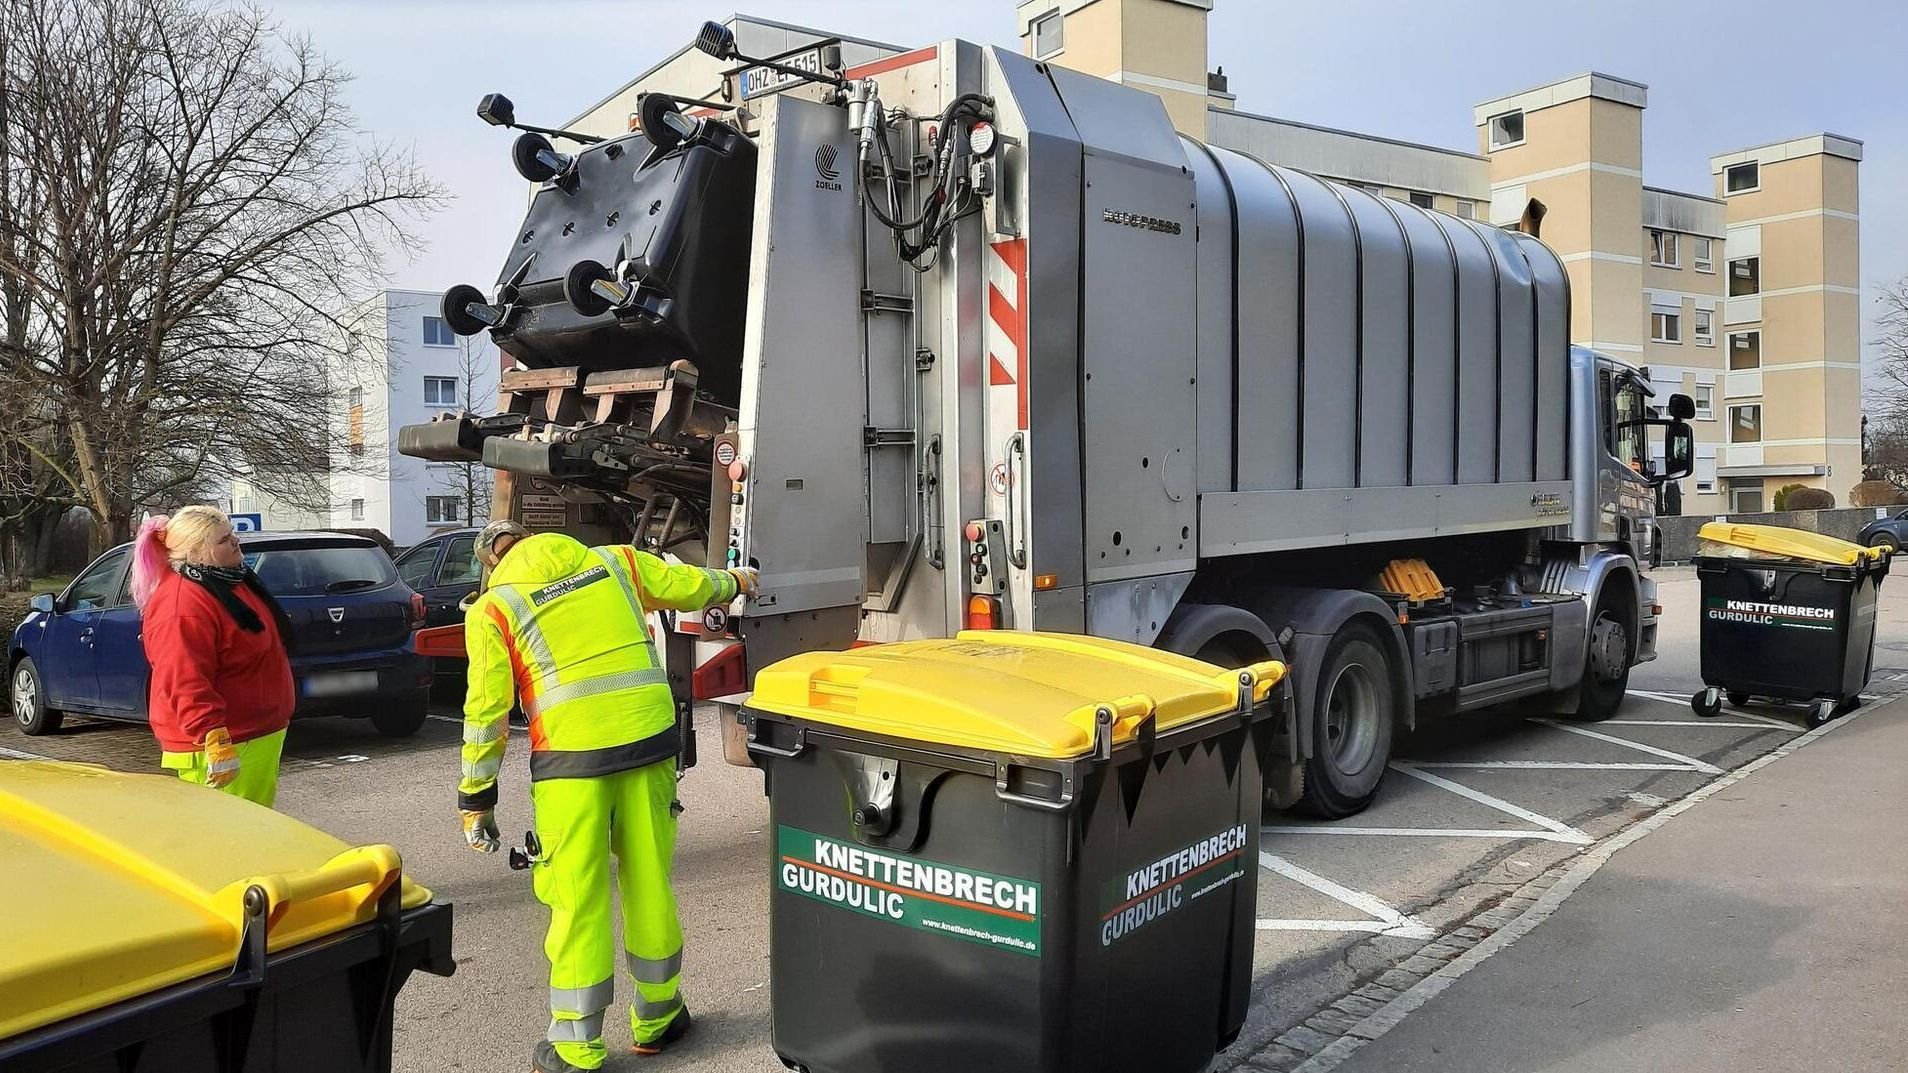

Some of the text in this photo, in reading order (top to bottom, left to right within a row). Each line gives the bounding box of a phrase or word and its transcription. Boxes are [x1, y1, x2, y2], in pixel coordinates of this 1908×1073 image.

[748, 68, 769, 92] OHZ
[815, 180, 843, 193] ZOELLER
[1827, 465, 1832, 478] 8
[535, 584, 577, 606] GURDULIC
[1708, 609, 1774, 625] GURDULIC
[1727, 600, 1835, 619] KNETTENBRECH
[1126, 823, 1247, 901] KNETTENBRECH
[815, 838, 1037, 915] KNETTENBRECH
[782, 863, 904, 919] GURDULIC
[1101, 884, 1183, 947] GURDULIC
[922, 918, 1036, 951] www.knettenbrech-gurdulic.de
